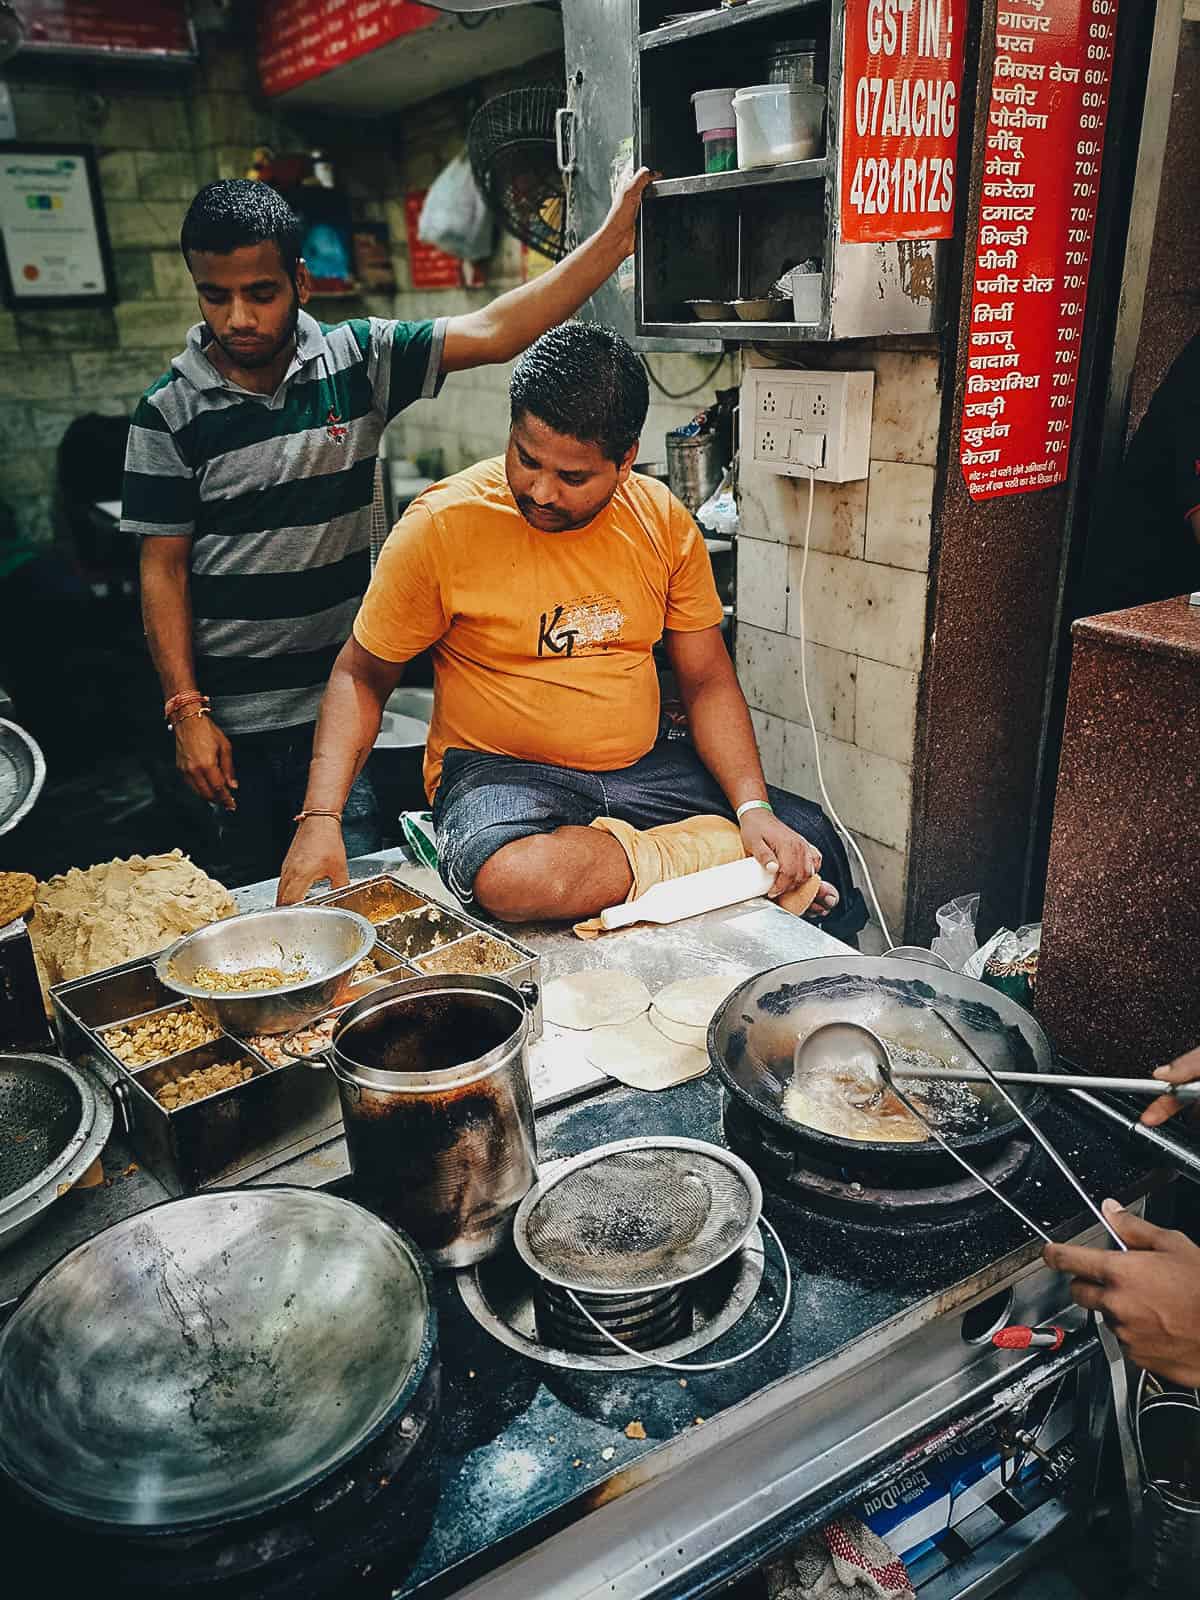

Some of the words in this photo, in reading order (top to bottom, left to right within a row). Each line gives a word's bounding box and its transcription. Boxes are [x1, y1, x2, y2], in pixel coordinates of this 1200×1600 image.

[1092, 0, 1116, 15] 60/-
[867, 0, 913, 56] GST
[998, 11, 1052, 32] गाजर
[1089, 24, 1113, 39] 60/-
[996, 34, 1036, 53] परत
[1087, 45, 1112, 60] 60/-
[994, 55, 1046, 81] मिक्स
[1049, 61, 1081, 83] वेज
[1084, 69, 1109, 84] 60/-
[992, 83, 1038, 106] पनीर
[1082, 92, 1106, 107] 60/-
[856, 77, 955, 137] 07AACHG
[990, 106, 1049, 129] पौदीना
[1080, 114, 1103, 129] 60/-
[987, 129, 1025, 159] नींबू
[1076, 141, 1101, 156] 60/-
[985, 155, 1022, 176] मेवा
[1075, 161, 1099, 176] 70/-
[983, 178, 1036, 199] करेला
[1072, 183, 1096, 198] 70/-
[982, 206, 1037, 221] टमाटर
[1070, 207, 1093, 222] 70/-
[980, 225, 1029, 246] भिन्डी
[1068, 229, 1091, 243] 70/-
[978, 249, 1019, 270] चीनी
[1065, 251, 1089, 265] 70/-
[976, 273, 1020, 294] पनीर
[1022, 274, 1055, 293] रोल
[1063, 275, 1086, 289] 70/-
[974, 302, 1015, 323] मिर्ची
[1060, 302, 1083, 316] 70/-
[971, 330, 1016, 351] काजू
[1057, 327, 1080, 341] 70/-
[969, 353, 1020, 370] बादाम
[1055, 350, 1077, 364] 70/-
[967, 371, 1041, 394] किशमिश
[1052, 373, 1075, 387] 70/-
[1050, 395, 1072, 409] 70/-
[963, 420, 1011, 448] खुर्चन
[1047, 420, 1070, 433] 70/-
[961, 448, 1001, 466] केला
[1045, 440, 1067, 454] 70/-
